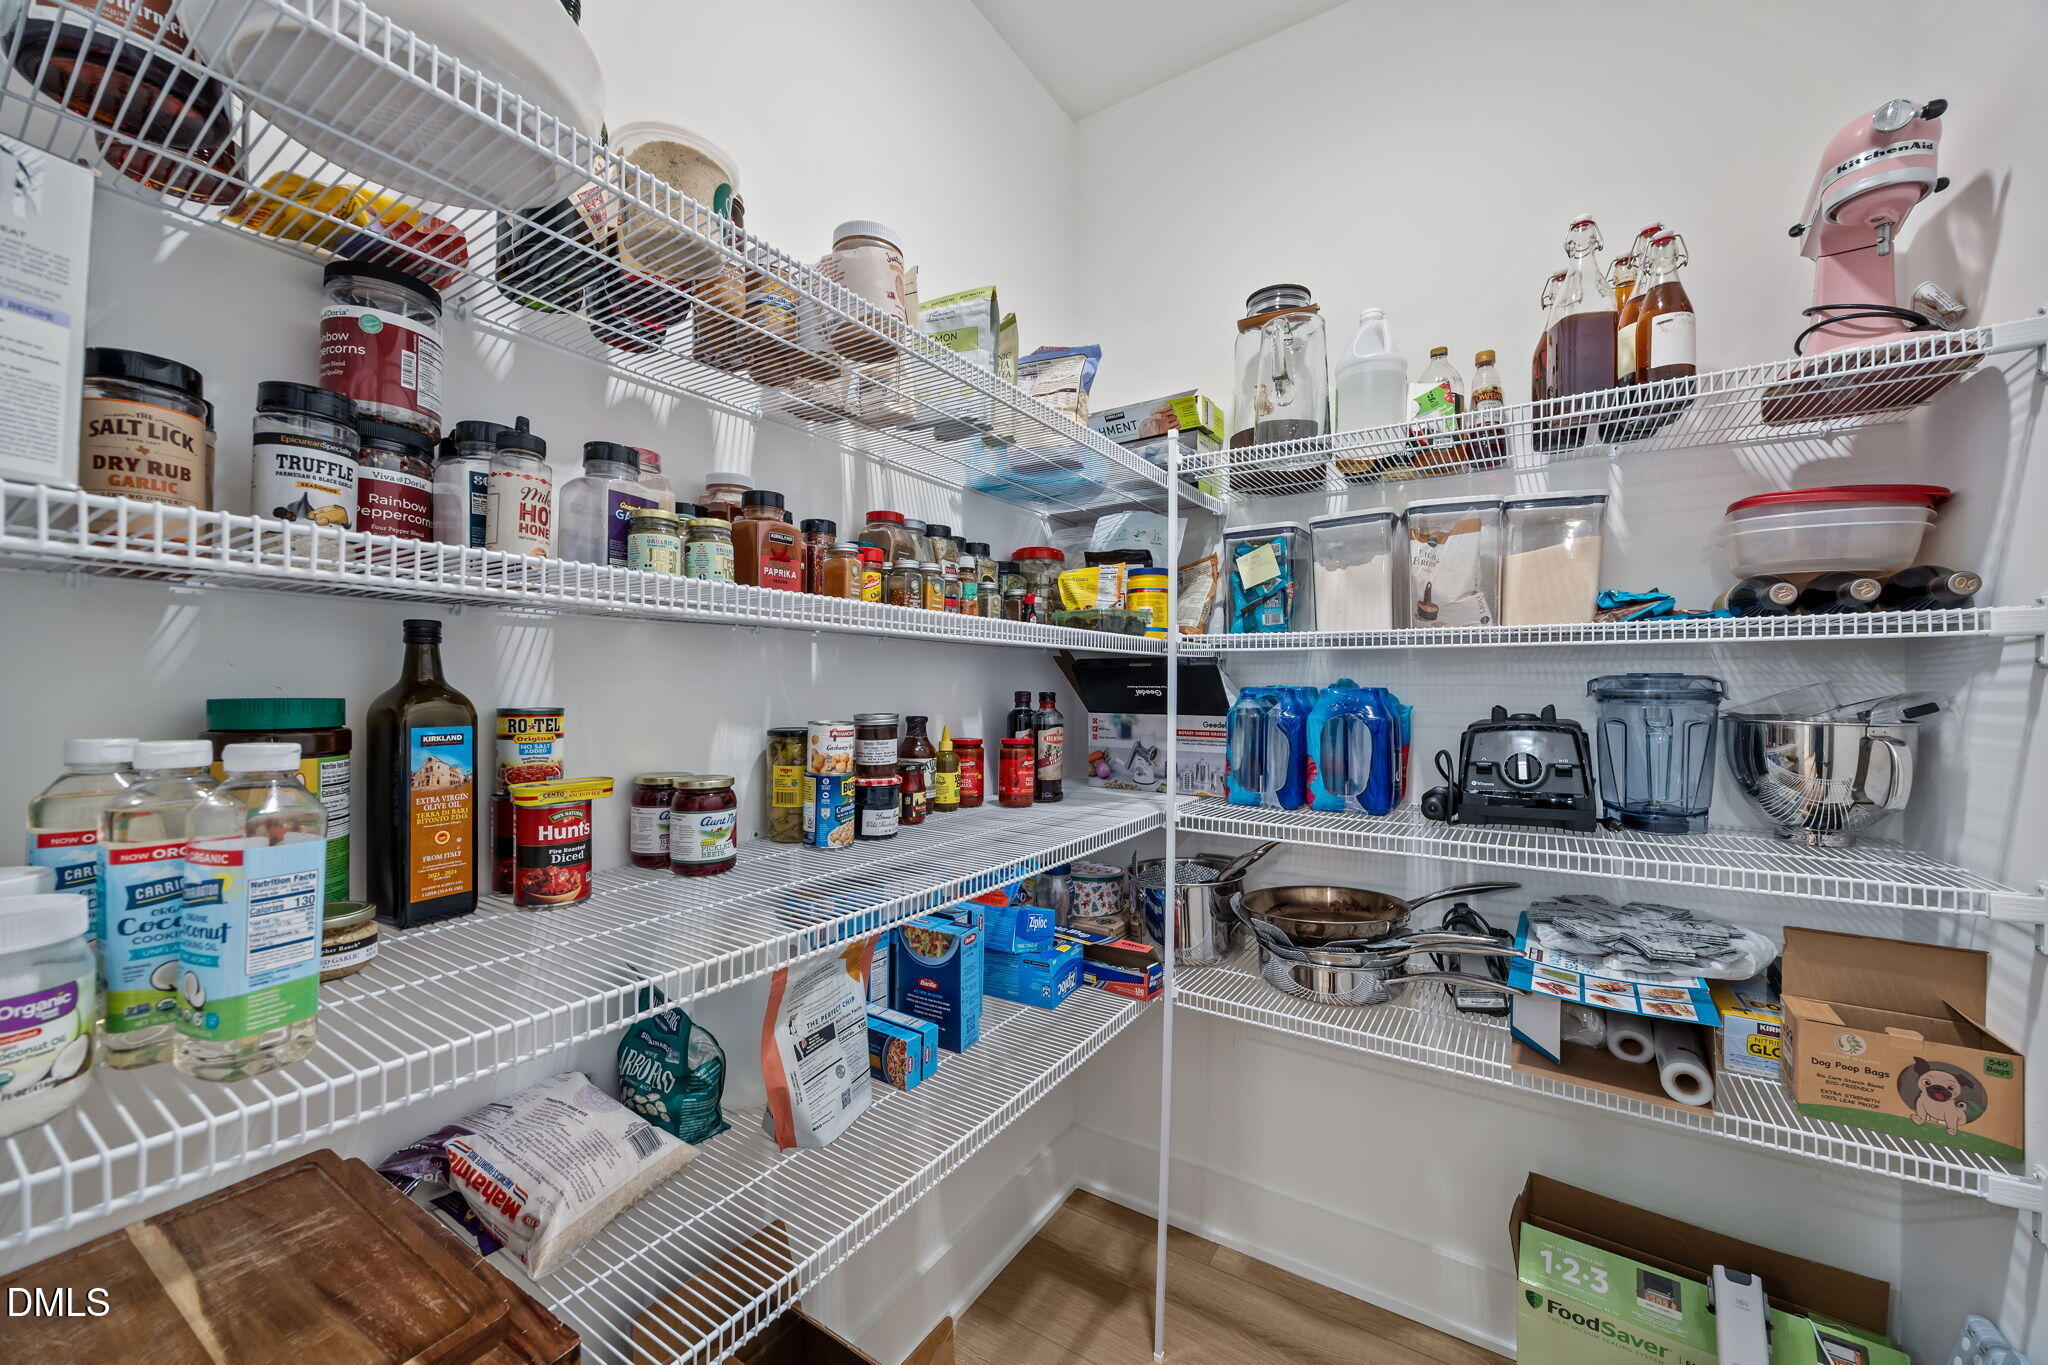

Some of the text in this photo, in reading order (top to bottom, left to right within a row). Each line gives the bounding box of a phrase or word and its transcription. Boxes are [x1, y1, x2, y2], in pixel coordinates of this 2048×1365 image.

[1836, 140, 1934, 175] KitchenAid
[89, 419, 196, 455] SALT LICK
[93, 455, 192, 482] DRY RUB
[276, 454, 354, 482] TRUFFLE
[275, 471, 312, 480] PARMESAN
[372, 471, 427, 490] Viva Doria
[107, 474, 178, 494] GARLIC
[369, 493, 428, 514] Rainbow
[520, 502, 551, 527] HO
[770, 533, 793, 542] KIRKLAND
[763, 567, 798, 579] PAPRIKA
[423, 735, 463, 743] KIRKLAND
[415, 793, 469, 806] EXTRA VIRGIN
[542, 791, 565, 799] CENTO
[423, 801, 461, 811] OLIVE OIL
[416, 811, 440, 819] TERRA
[452, 807, 469, 815] BARI
[416, 816, 450, 825] BITONTO
[701, 816, 726, 827] Aunt
[538, 822, 591, 841] Hunt's
[50, 836, 79, 845] NOW
[563, 844, 586, 852] Roasted
[119, 852, 149, 862] NOW
[422, 851, 462, 863] FROM ITALY
[550, 853, 585, 864] Diced
[250, 872, 317, 889] Nutrition Facts
[294, 894, 316, 907] 130
[249, 903, 285, 915] Calories
[1029, 916, 1048, 931] Ziploc
[338, 943, 358, 952] Ranch
[332, 953, 361, 964] GARLIC
[920, 979, 937, 988] Barilla
[806, 996, 856, 1029] THE PERFECT CHIP
[1811, 1057, 1890, 1079] Dog Poop Bags
[1988, 1059, 2009, 1068] 540
[619, 1047, 676, 1094] ARBORIO
[1986, 1065, 2011, 1076] Bags
[1825, 1080, 1875, 1093] ECO-FRIENDLY
[1843, 1077, 1865, 1086] Starch
[1867, 1081, 1885, 1090] Blend
[1820, 1089, 1881, 1104] EXTRA STRENGTH
[1821, 1094, 1880, 1110] 100% LEAK PROOF
[1547, 1299, 1673, 1359] FoodSaver
[1573, 1324, 1600, 1339] VACUUM
[1602, 1337, 1634, 1353] SEALING
[1634, 1349, 1665, 1365] SYSTEM
